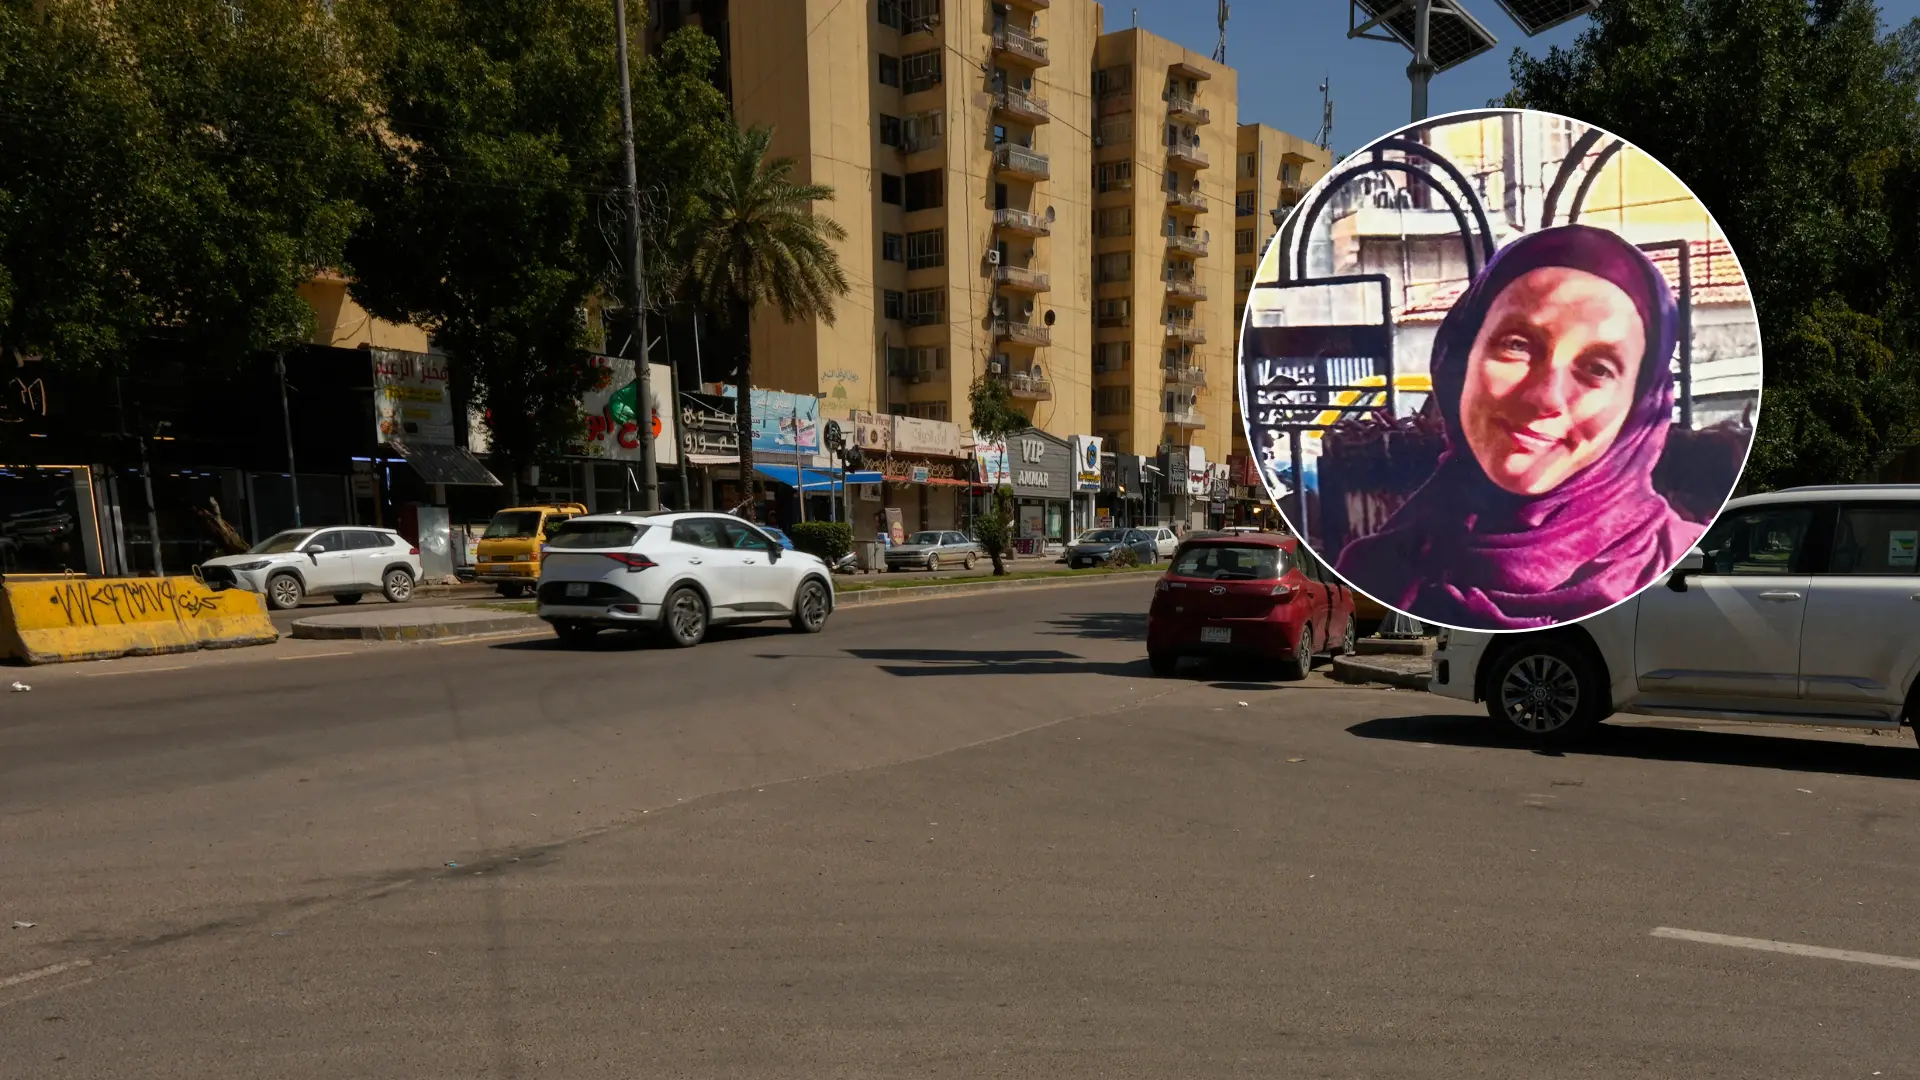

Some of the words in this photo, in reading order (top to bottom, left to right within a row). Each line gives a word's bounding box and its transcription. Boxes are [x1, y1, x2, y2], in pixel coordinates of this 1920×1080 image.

[857, 412, 873, 425] Brand
[1021, 439, 1045, 464] VIP
[1018, 470, 1049, 488] AMMAR
